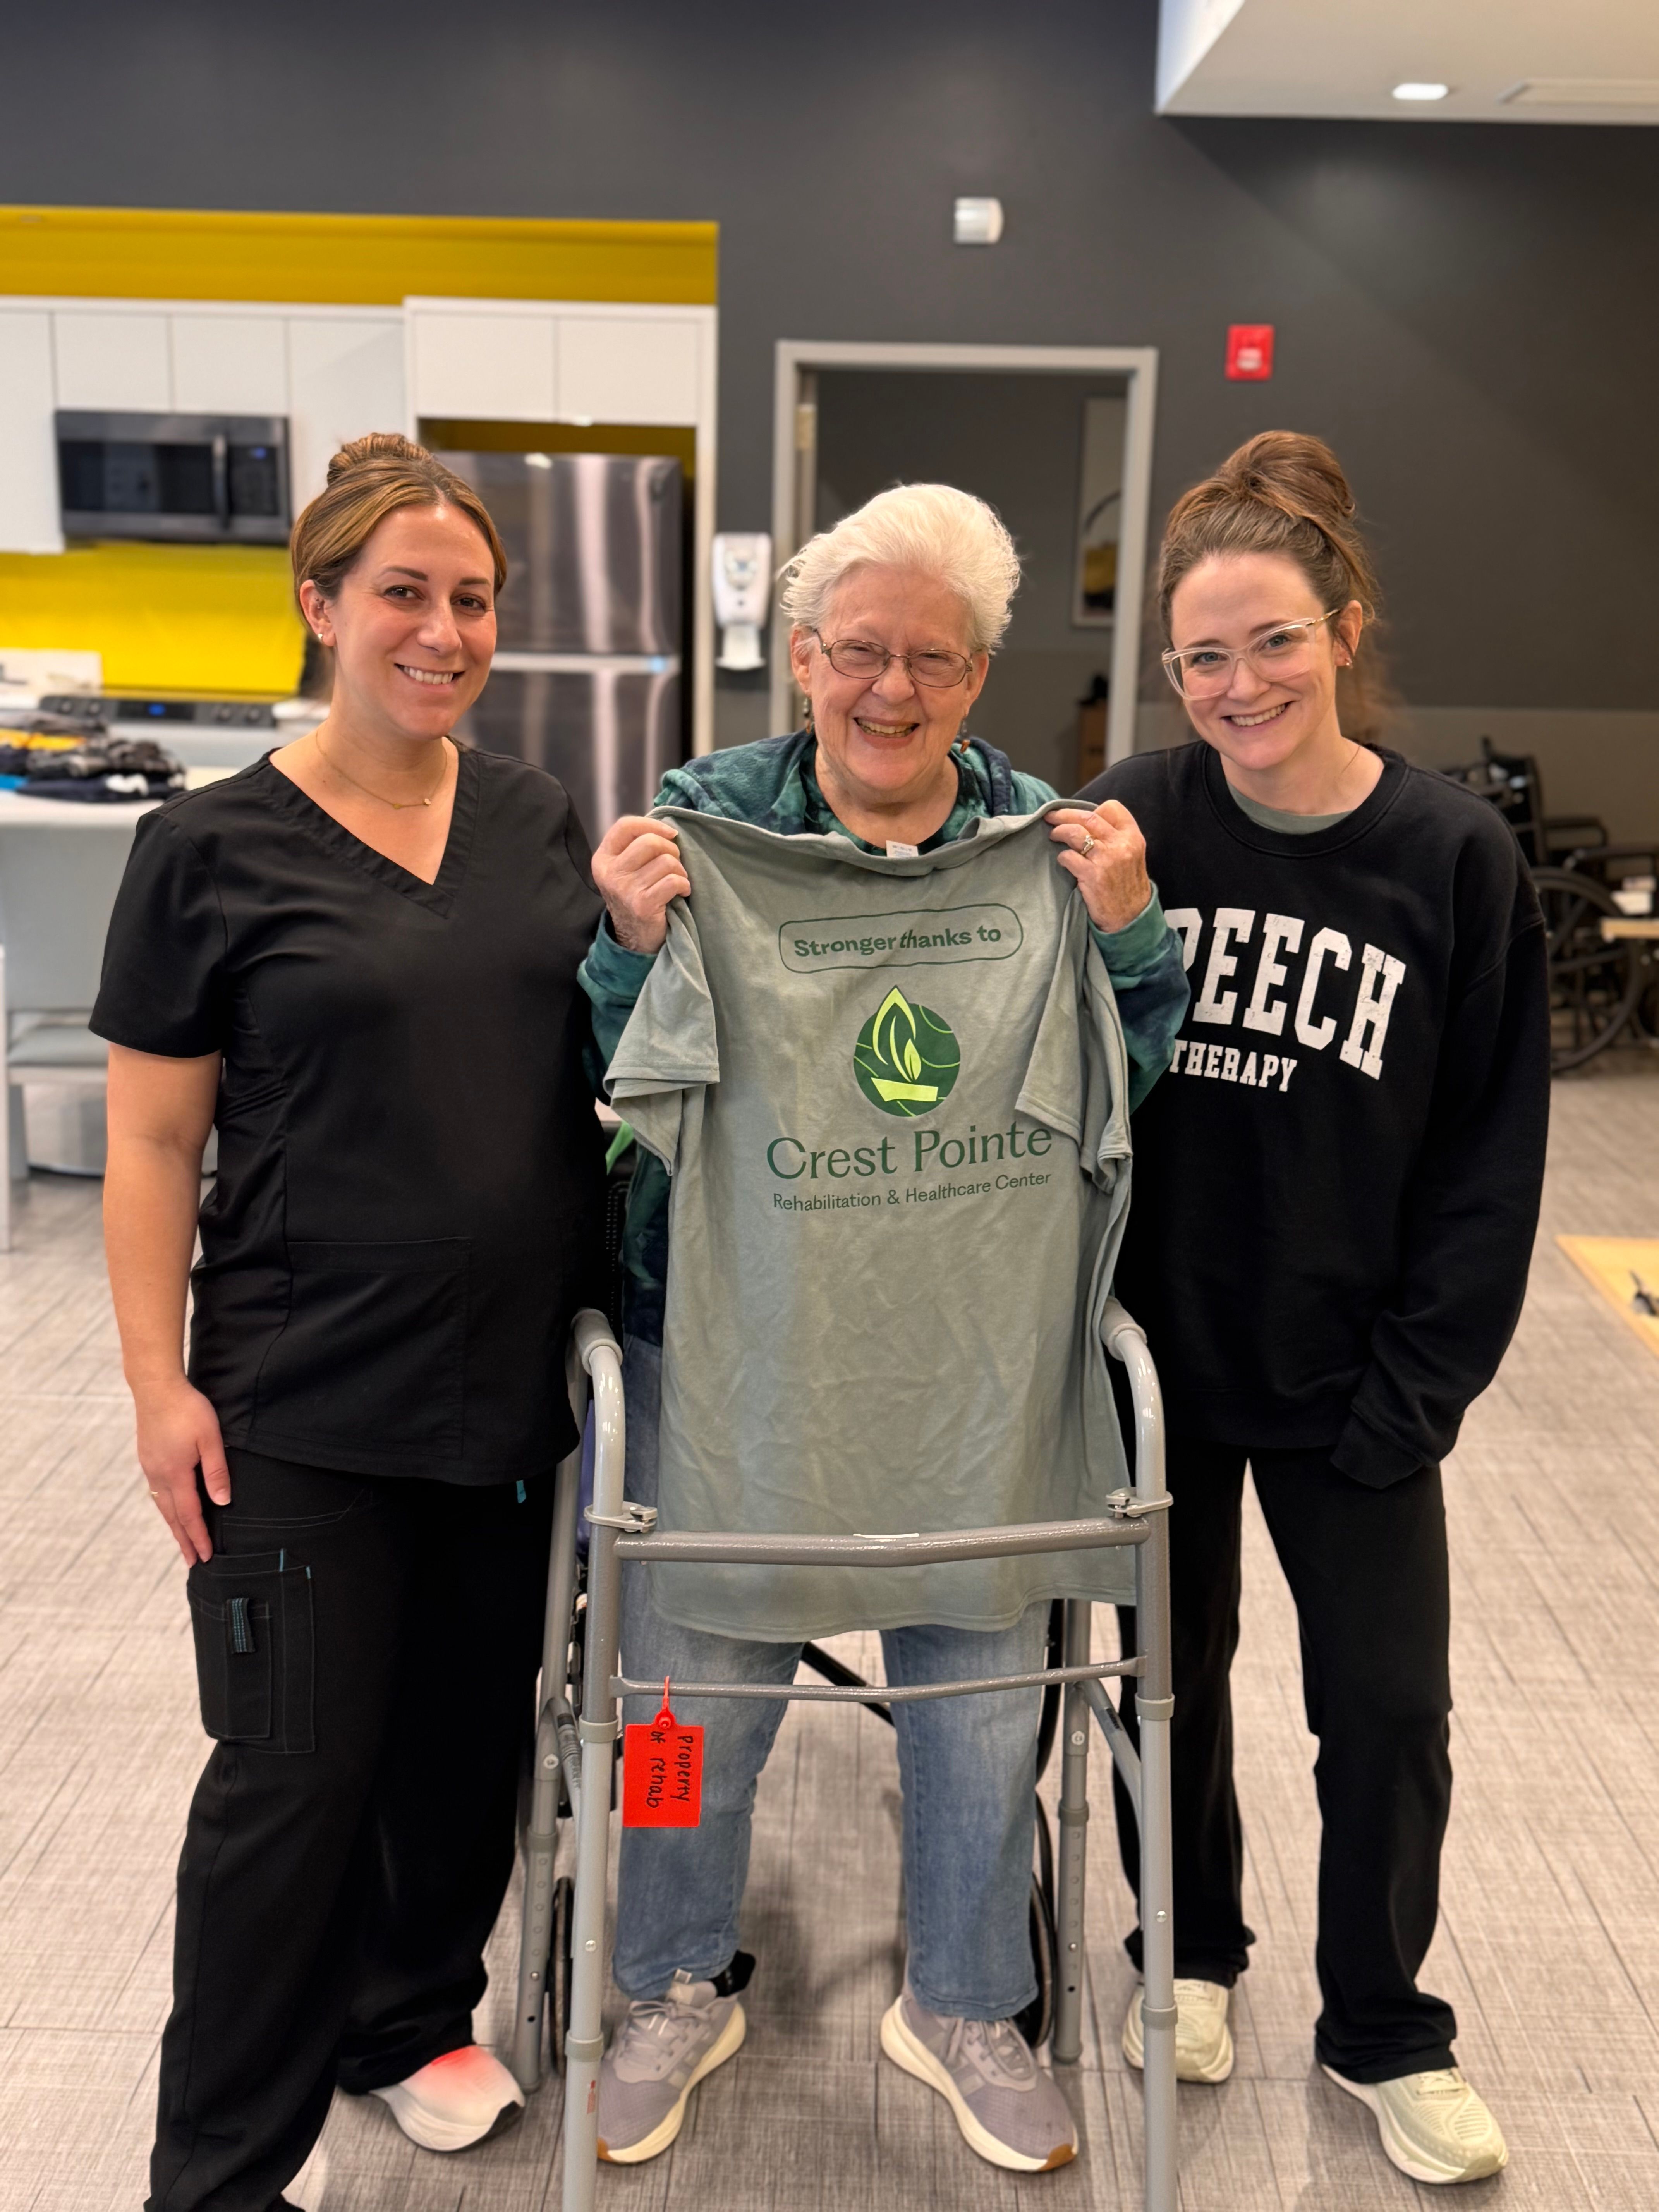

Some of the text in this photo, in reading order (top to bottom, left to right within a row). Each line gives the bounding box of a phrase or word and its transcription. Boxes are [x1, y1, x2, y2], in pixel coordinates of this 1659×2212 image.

[794, 925, 1001, 957] Stronger thanks to
[766, 1121, 1053, 1180] Crest Pointe
[773, 1172, 1052, 1211] Rehabilitation & Healthcare Center
[646, 1731, 668, 1808] of rehab
